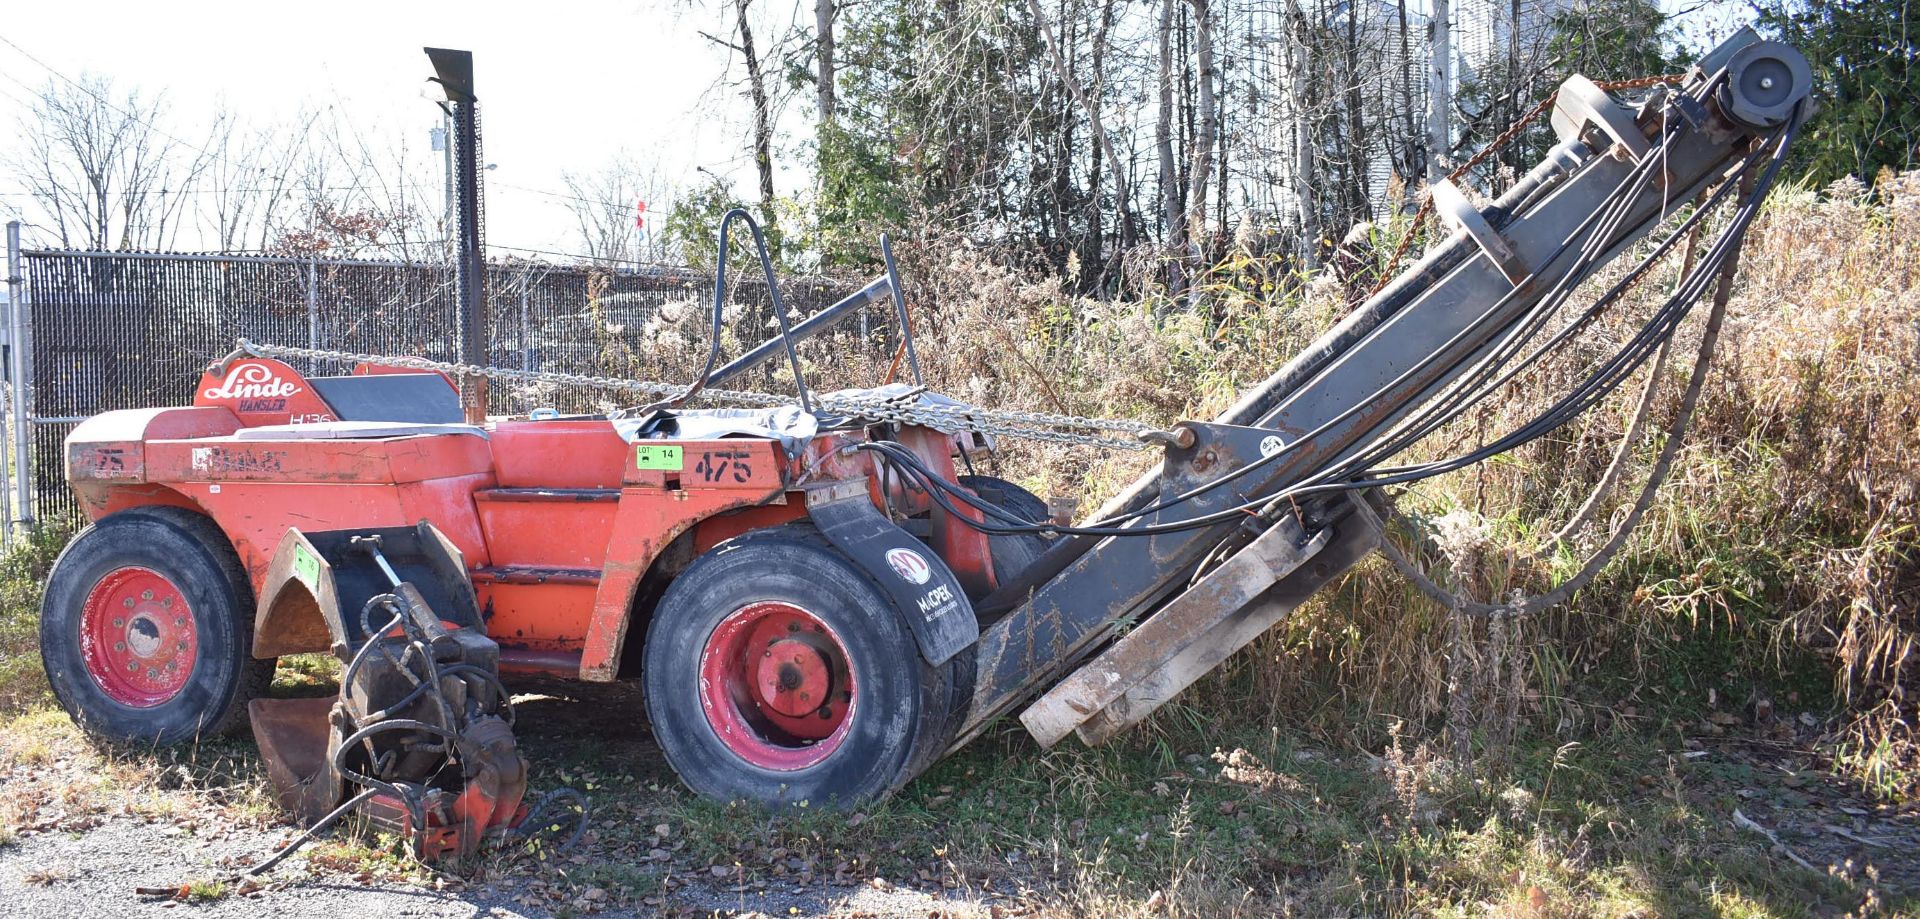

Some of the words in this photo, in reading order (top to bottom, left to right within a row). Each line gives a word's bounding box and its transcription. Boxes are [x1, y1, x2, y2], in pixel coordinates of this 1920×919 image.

[203, 363, 302, 399] Linde
[239, 399, 286, 412] HANSLER
[662, 449, 674, 459] 14
[695, 452, 752, 483] 475
[916, 584, 954, 614] MACPEK
